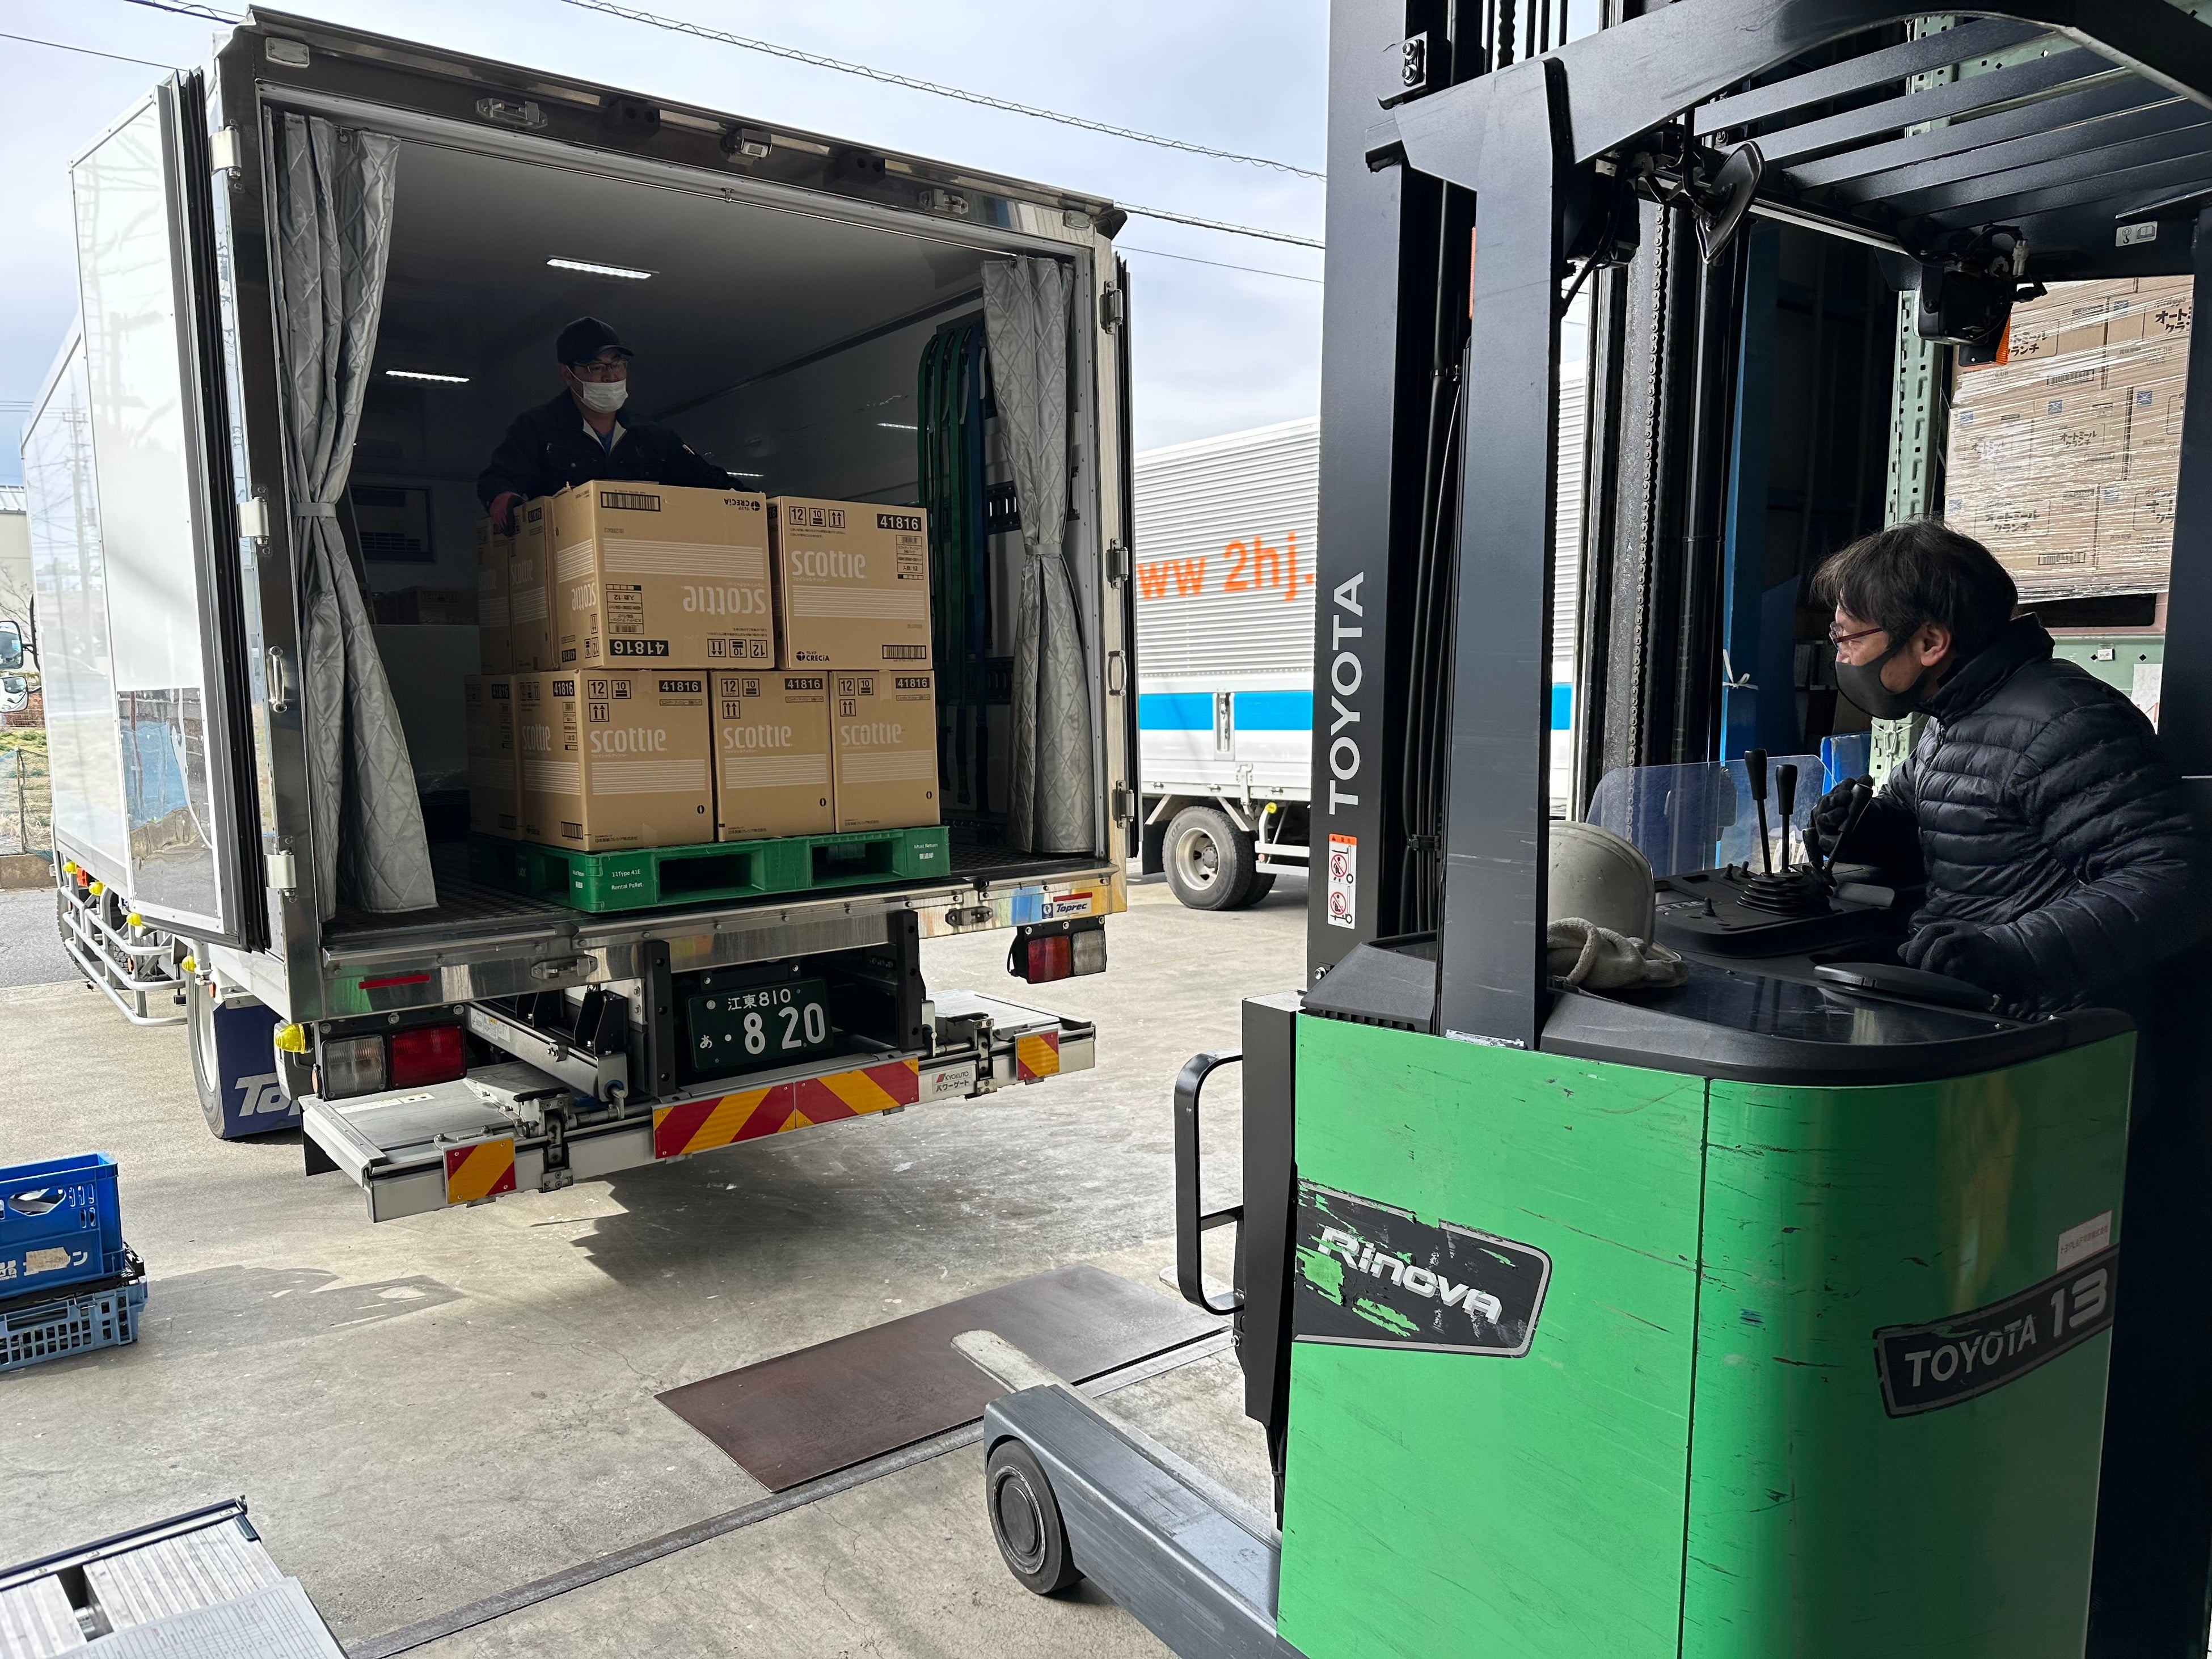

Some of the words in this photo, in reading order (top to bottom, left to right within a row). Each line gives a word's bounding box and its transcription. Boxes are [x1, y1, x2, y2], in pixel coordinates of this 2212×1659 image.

[2008, 343, 2039, 356] ランチ
[2059, 430, 2097, 441] オートミール
[792, 509, 803, 520] 12
[880, 516, 918, 530] 41816
[791, 550, 866, 579] scottie
[571, 582, 596, 611] scottie
[683, 585, 766, 615] scottie
[614, 640, 665, 655] 41816
[753, 644, 766, 657] 12
[562, 648, 576, 661] 41816
[554, 682, 574, 695] 41816
[591, 682, 605, 694] 12
[662, 681, 699, 691] 41816
[724, 680, 736, 691] 12
[787, 679, 821, 689] 41816
[841, 679, 852, 691] 12
[898, 678, 927, 688] 41816
[493, 685, 509, 698] 41816
[1329, 571, 1364, 815] TOYOTA
[522, 724, 551, 752] scottie
[590, 727, 666, 753] scottie
[724, 724, 792, 749] scottie
[841, 723, 903, 746] scottie
[1057, 902, 1087, 913] Toprec
[699, 1035, 713, 1049] あ
[936, 1079, 969, 1092] パワーゲート
[1905, 1314, 2037, 1387] TOYOTA
[2050, 1268, 2108, 1338] 13
